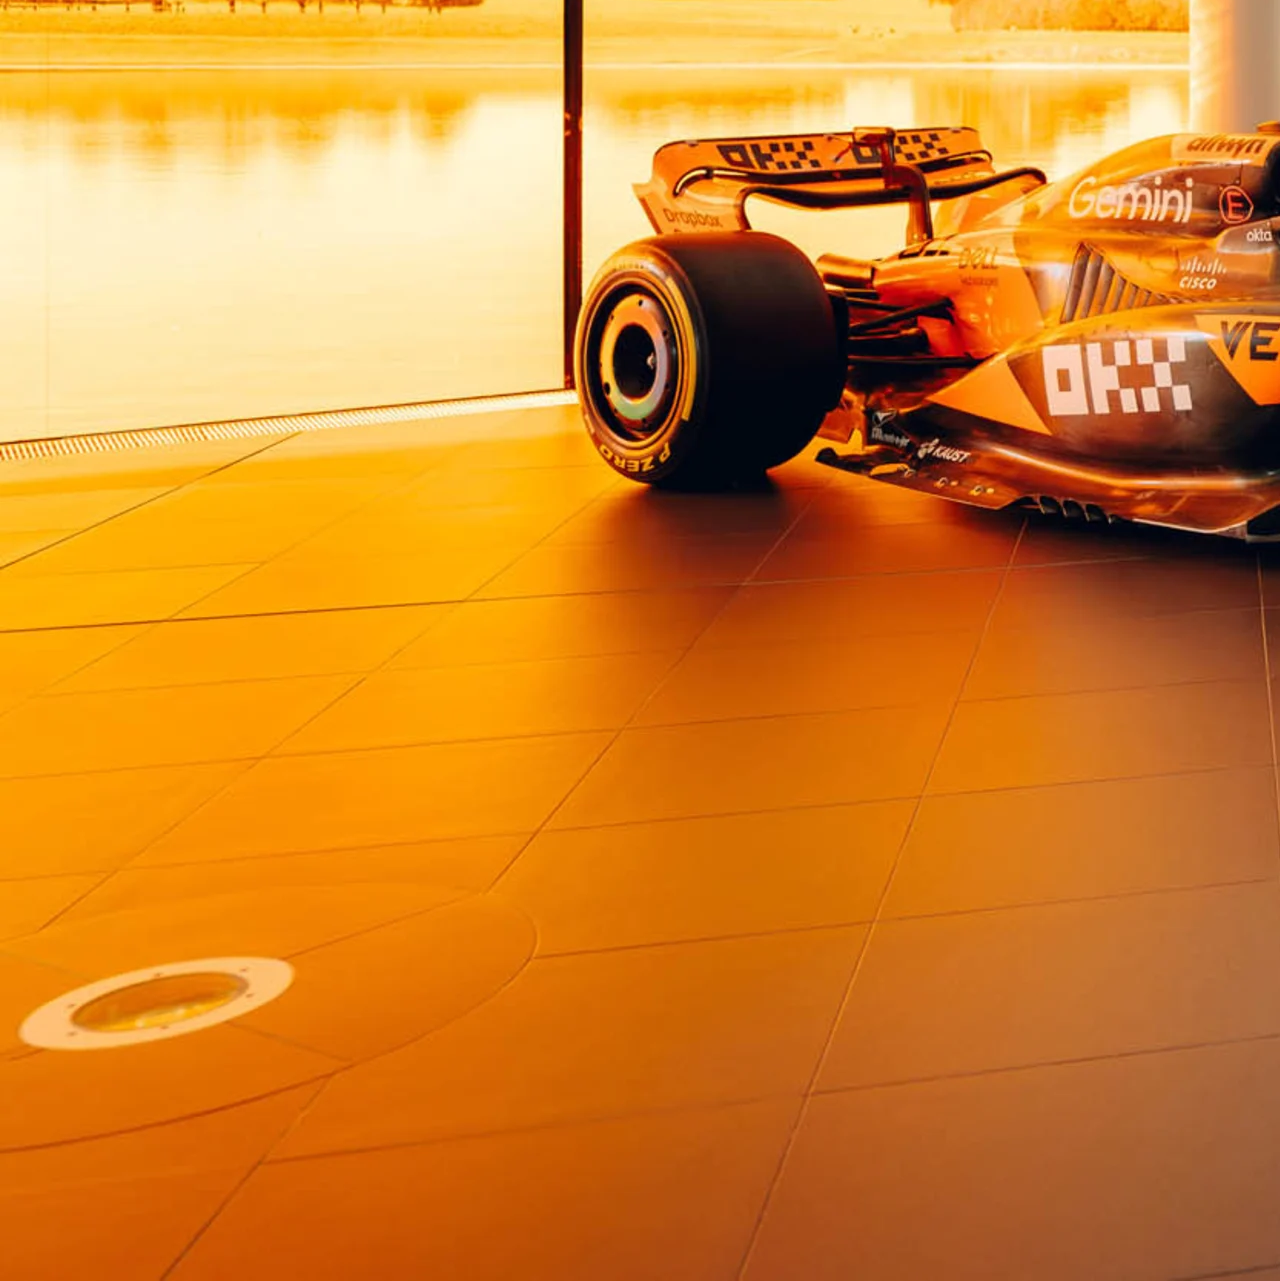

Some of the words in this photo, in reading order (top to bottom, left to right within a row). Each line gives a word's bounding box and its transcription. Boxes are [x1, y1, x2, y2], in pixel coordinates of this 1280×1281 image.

[1069, 176, 1193, 223] Gemini
[1246, 228, 1273, 242] okta
[599, 443, 655, 473] ZERO
[932, 446, 971, 463] KAUST
